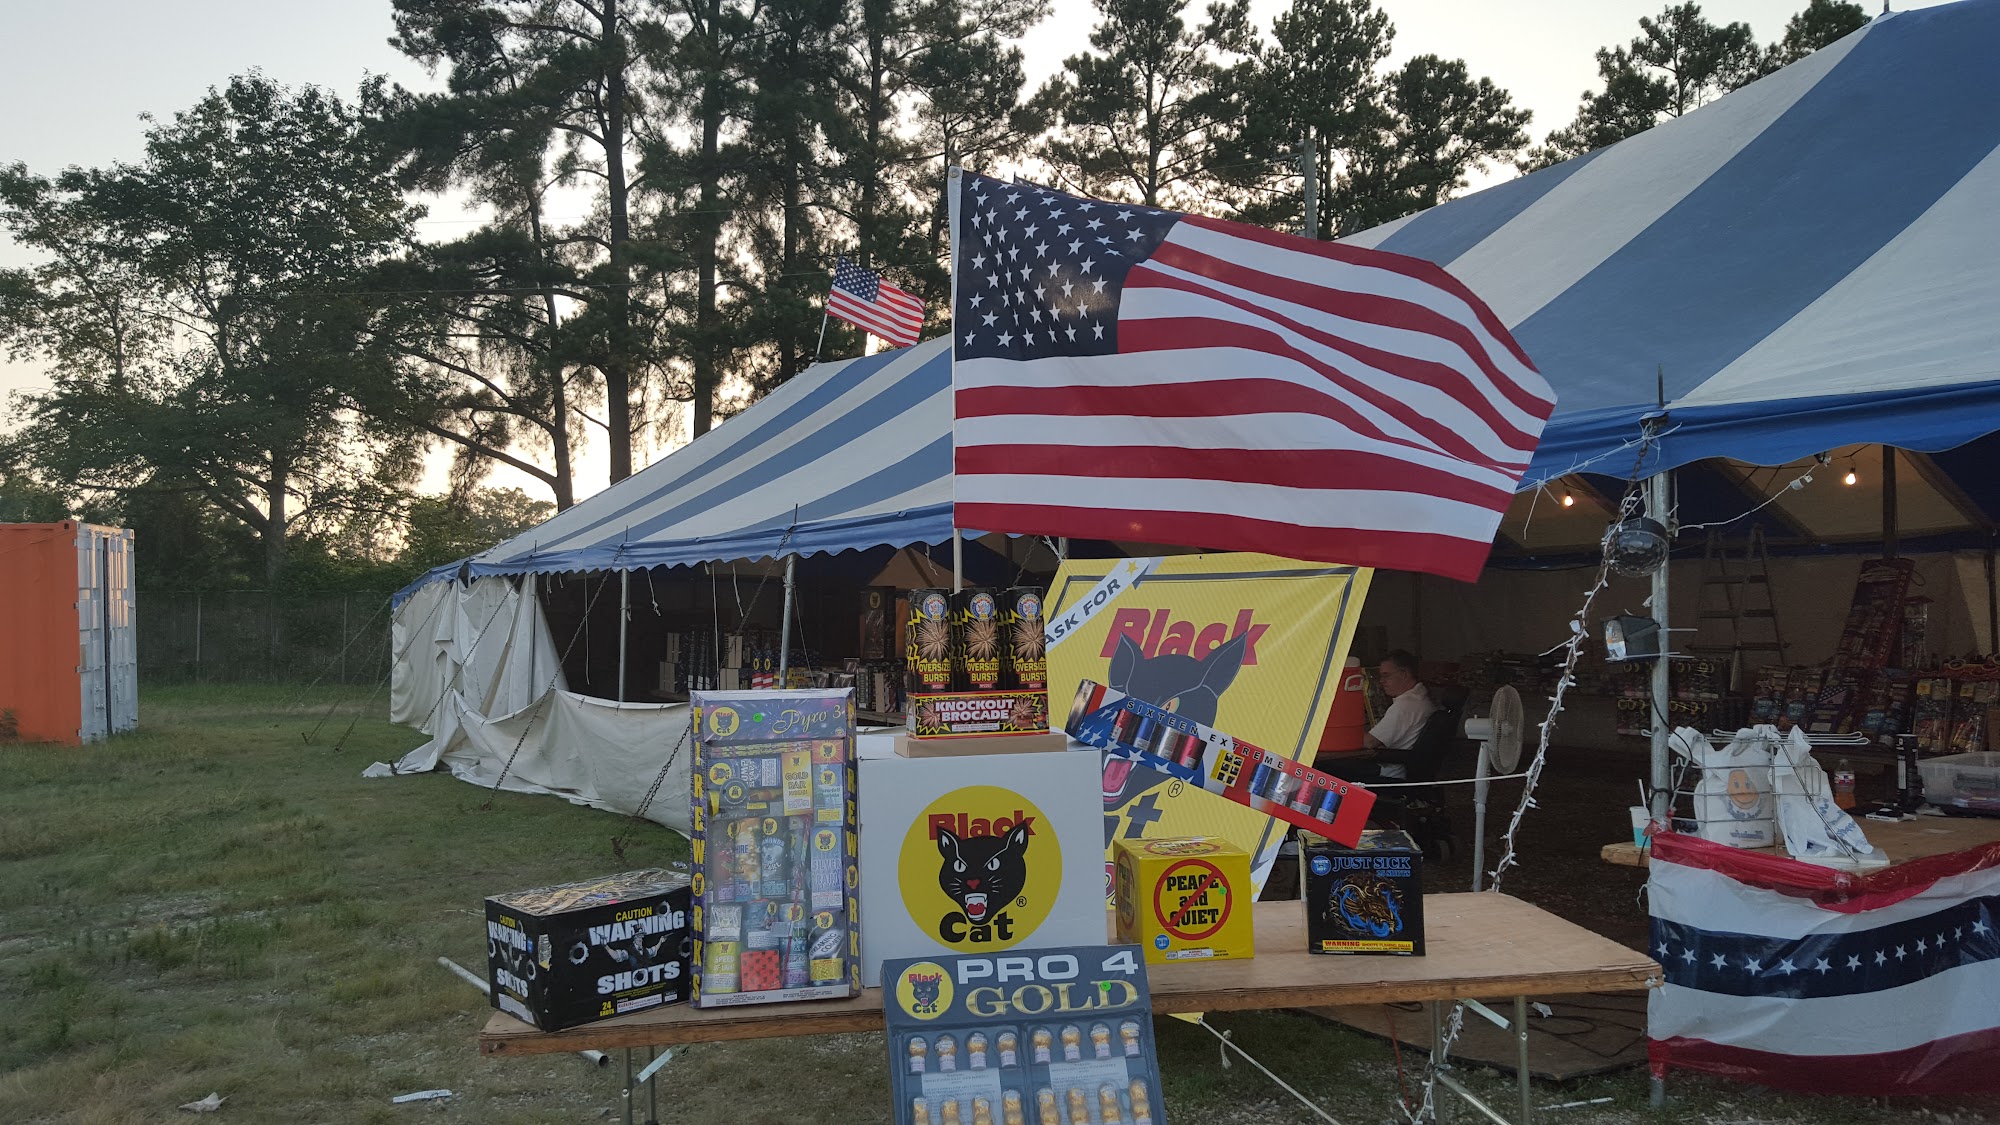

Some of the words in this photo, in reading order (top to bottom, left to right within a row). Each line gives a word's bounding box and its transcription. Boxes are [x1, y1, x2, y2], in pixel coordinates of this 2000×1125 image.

[1043, 616, 1080, 647] ASK
[1082, 578, 1121, 618] FOR
[1099, 608, 1271, 666] Black
[923, 673, 950, 682] BURSTS
[971, 672, 998, 682] BURSTS
[1020, 672, 1047, 682] BURSTS
[935, 699, 1015, 712] KNOCKOUT
[772, 709, 827, 734] Pyro
[832, 705, 842, 719] 3
[941, 709, 1009, 722] BROCADE
[1127, 700, 1199, 736] SIXTEEN
[1209, 733, 1285, 769] EXTREME
[1295, 768, 1348, 795] SHOTS
[785, 772, 808, 781] GOLD
[788, 781, 807, 790] BAR
[928, 810, 1037, 841] Black
[1332, 856, 1372, 872] JUST
[1373, 856, 1411, 870] SICK
[1166, 873, 1220, 892] PEACE
[1179, 890, 1208, 908] and
[499, 914, 516, 929] CAUTION
[615, 906, 653, 922] CAUTION
[1169, 908, 1219, 928] QUIET
[487, 919, 527, 952] WARNING
[588, 910, 685, 947] WARNING
[939, 911, 1014, 943] Cat
[956, 954, 1080, 985] PRO
[1101, 950, 1139, 975] 4
[496, 967, 529, 999] SHOTS
[597, 960, 681, 995] SHOTS
[908, 972, 943, 983] Black
[602, 1000, 612, 1010] 24
[965, 979, 1138, 1018] GOLD
[912, 1002, 938, 1015] Cat
